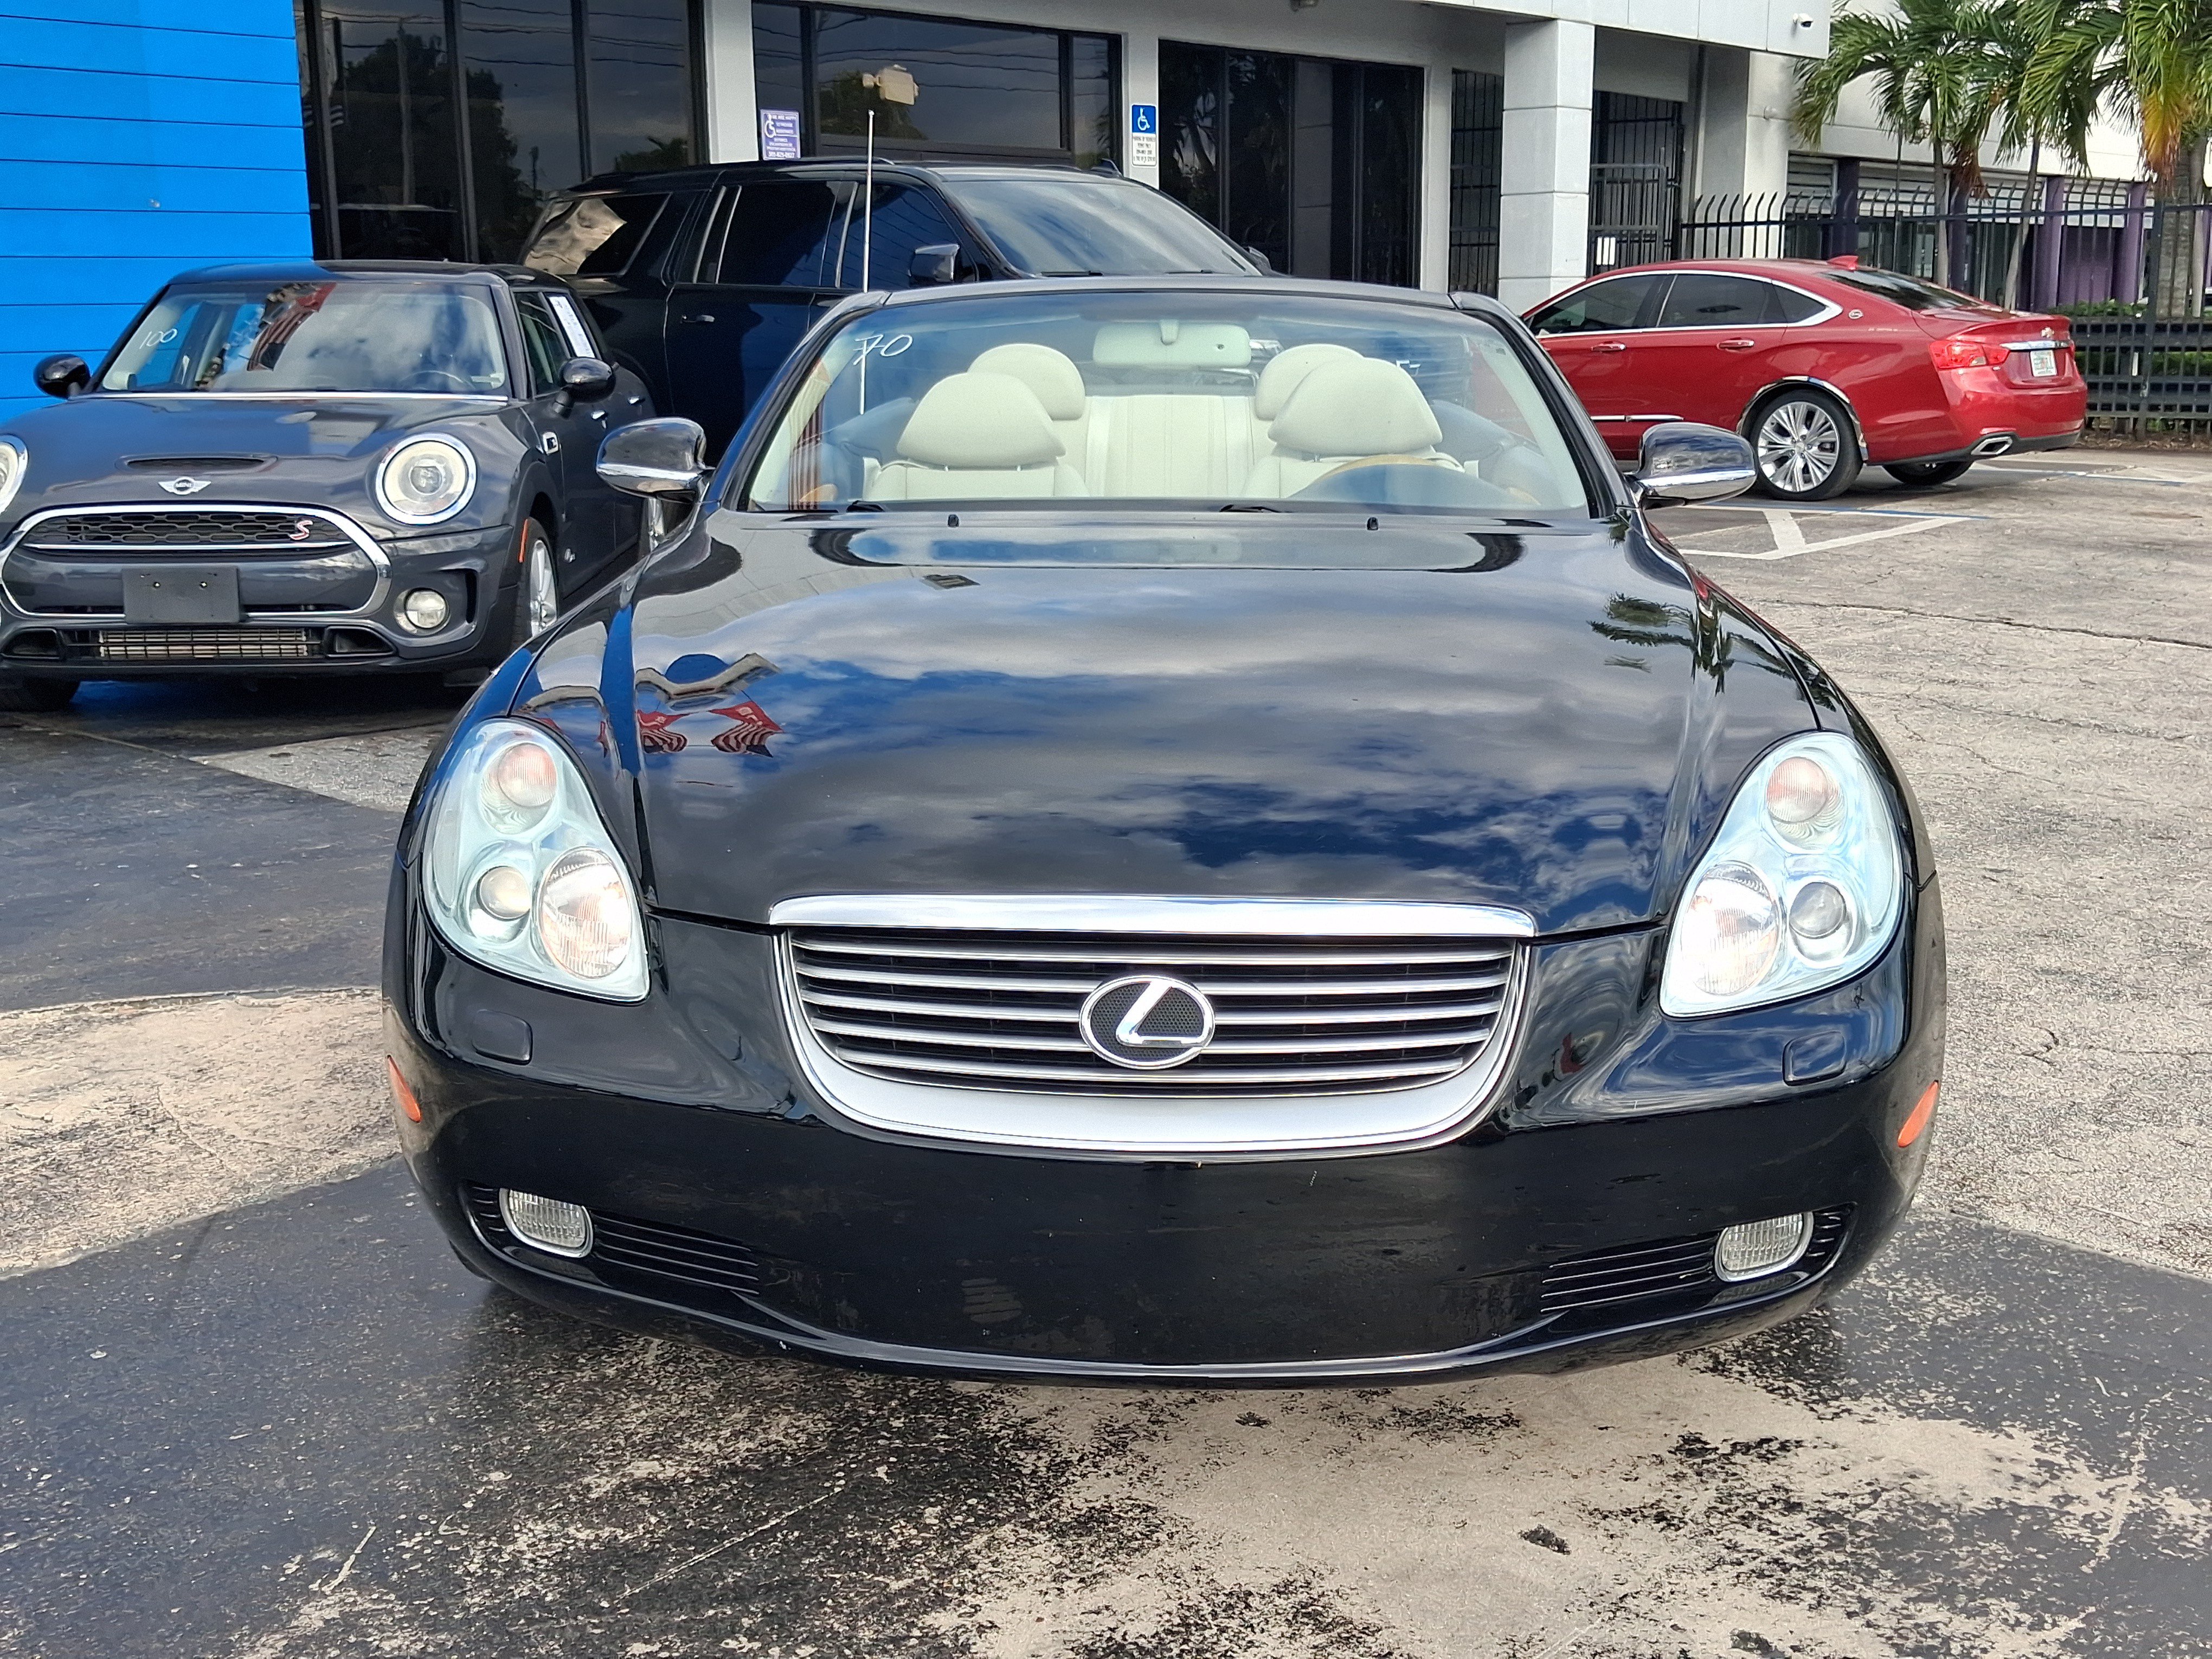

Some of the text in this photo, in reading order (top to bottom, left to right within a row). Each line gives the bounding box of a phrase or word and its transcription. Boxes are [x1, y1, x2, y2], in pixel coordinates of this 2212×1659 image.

[139, 329, 178, 350] 100
[853, 333, 913, 365] 70
[290, 520, 313, 541] S
